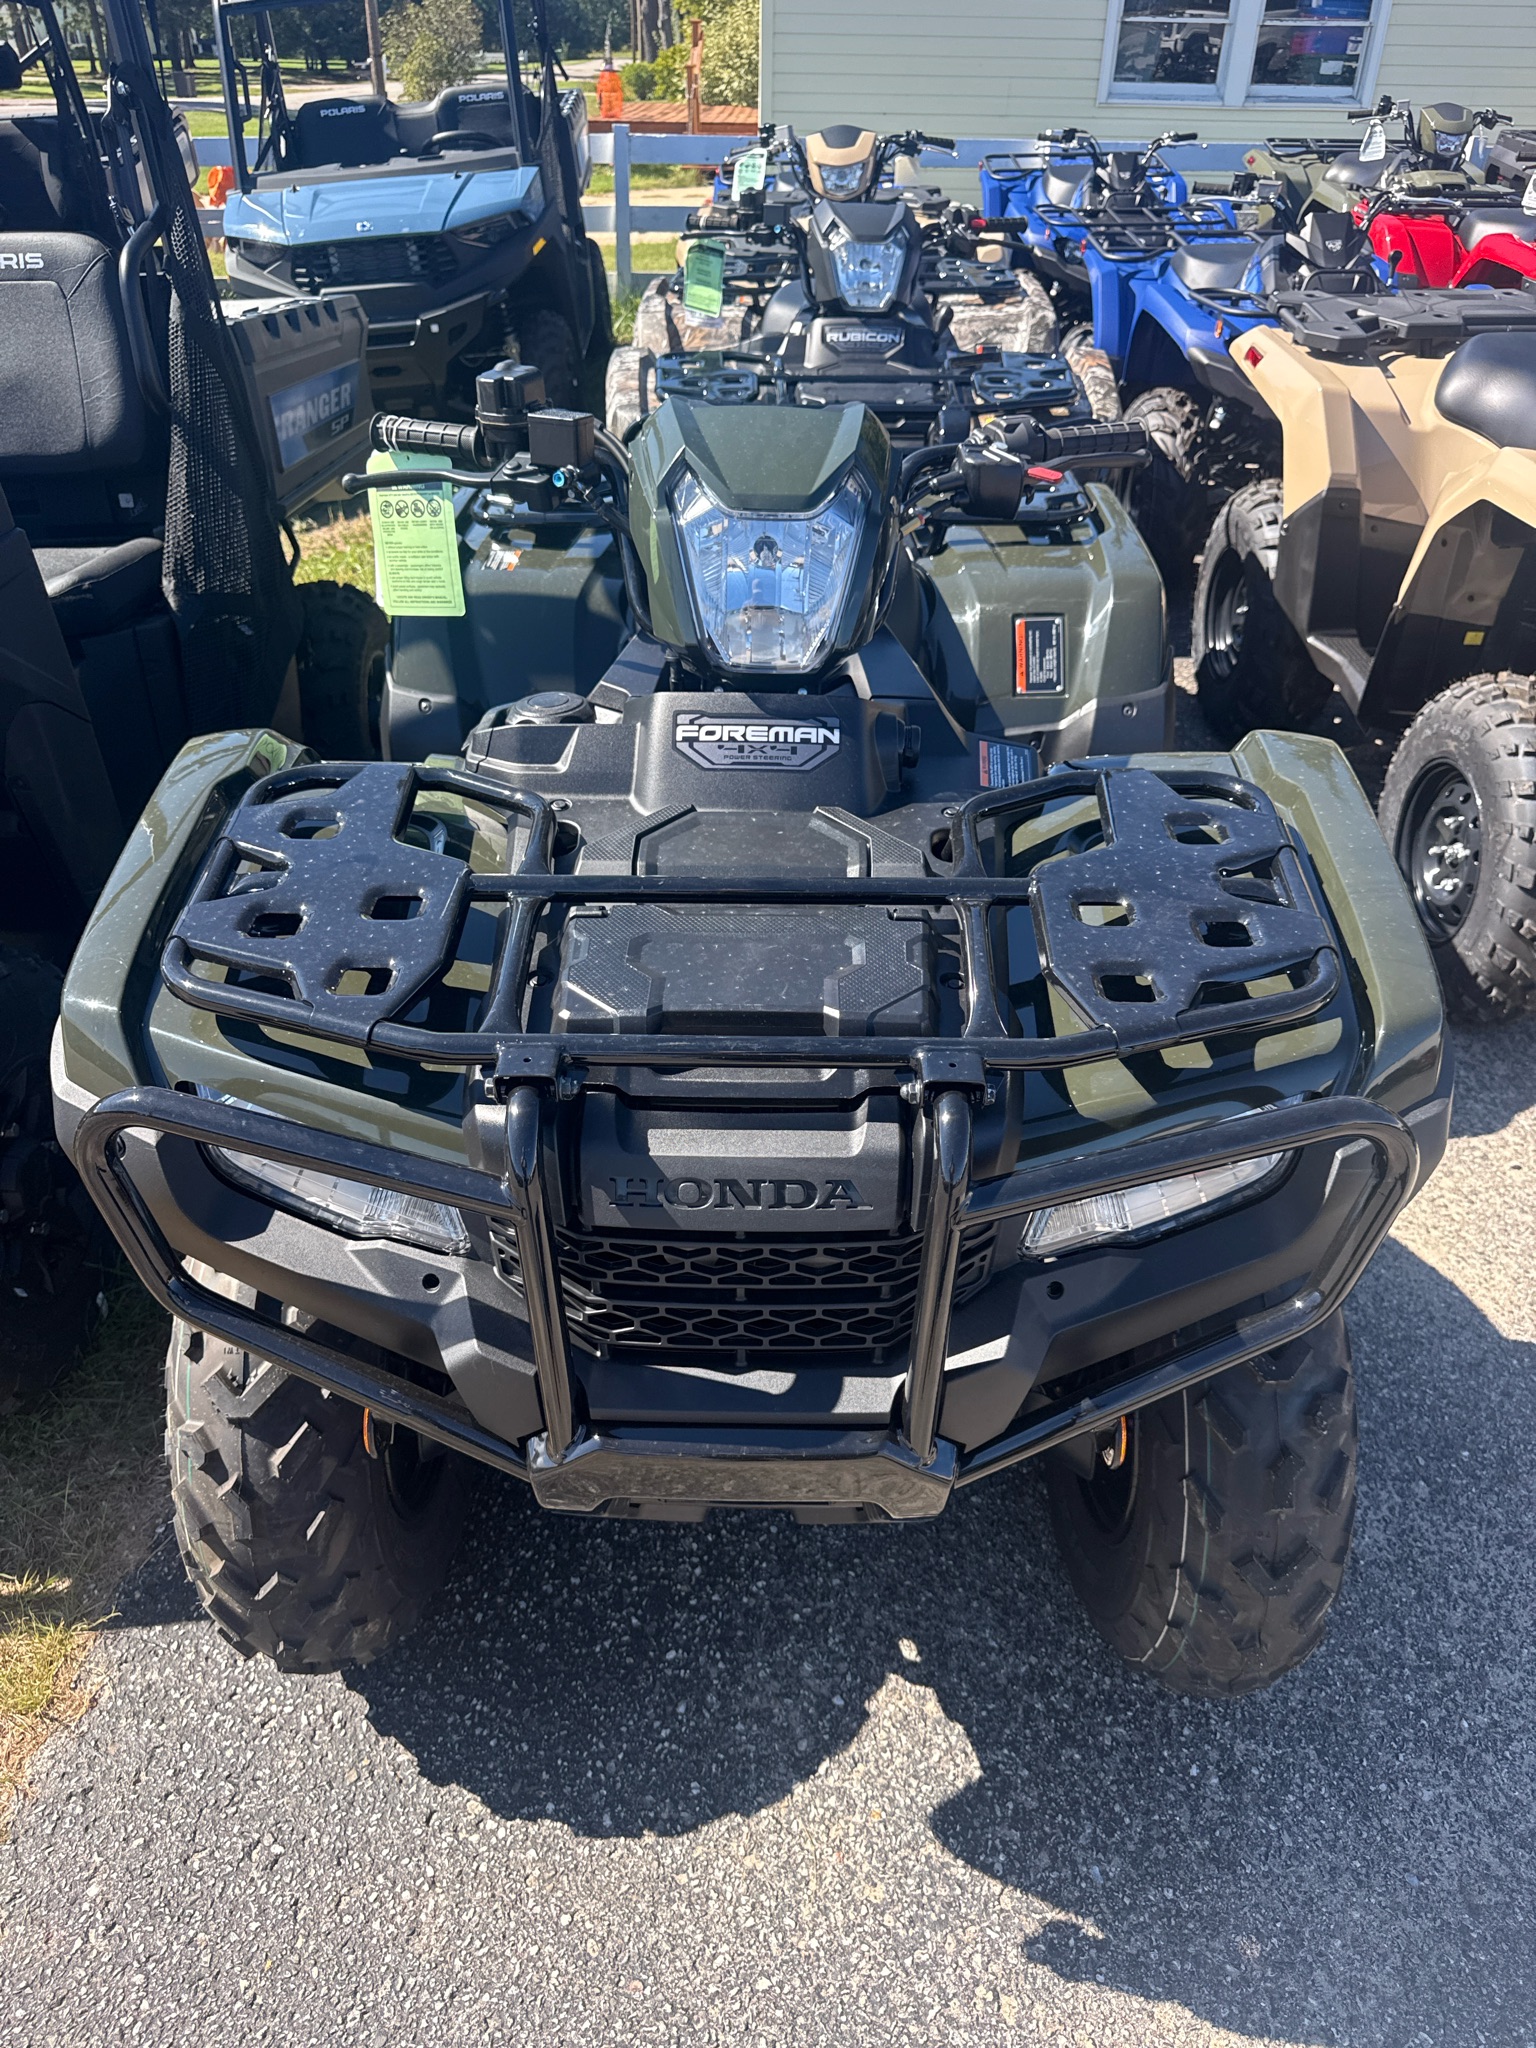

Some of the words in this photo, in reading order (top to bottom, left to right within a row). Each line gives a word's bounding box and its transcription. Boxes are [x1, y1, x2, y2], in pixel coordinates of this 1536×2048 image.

[458, 91, 505, 103] POLARIS
[320, 105, 366, 118] POLARIS
[826, 332, 900, 343] RUBICON
[281, 382, 351, 441] RANGER
[331, 413, 350, 437] SP
[675, 724, 840, 744] FOREMAN
[609, 1177, 873, 1210] HONDA
